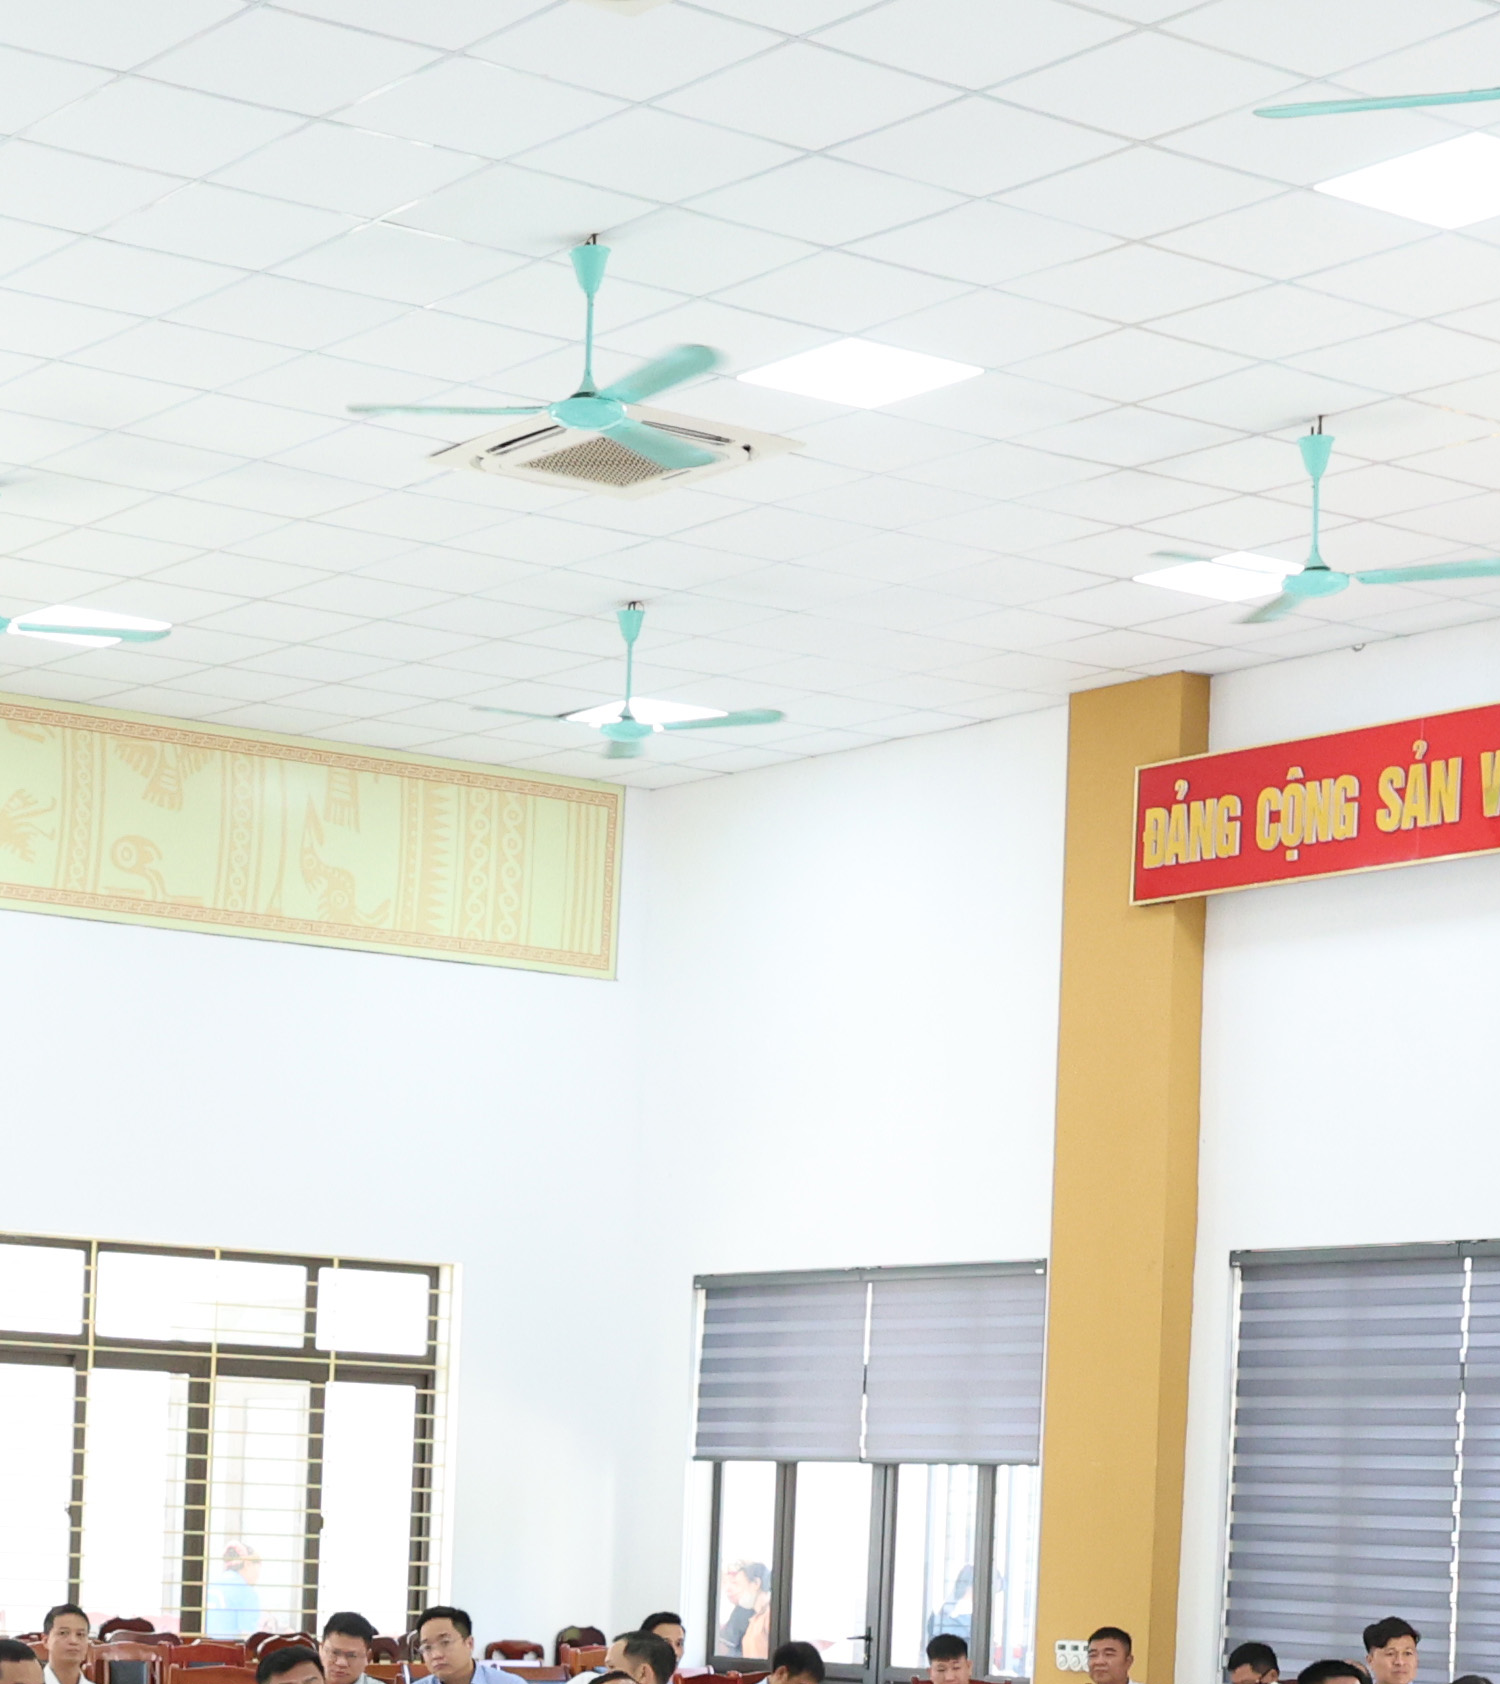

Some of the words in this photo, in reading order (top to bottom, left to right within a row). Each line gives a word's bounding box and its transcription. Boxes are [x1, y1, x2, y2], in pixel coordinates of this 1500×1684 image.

[1142, 779, 1241, 869] ĐẢNG
[1256, 767, 1359, 861] CỘNG
[1376, 739, 1462, 833] SẢN
